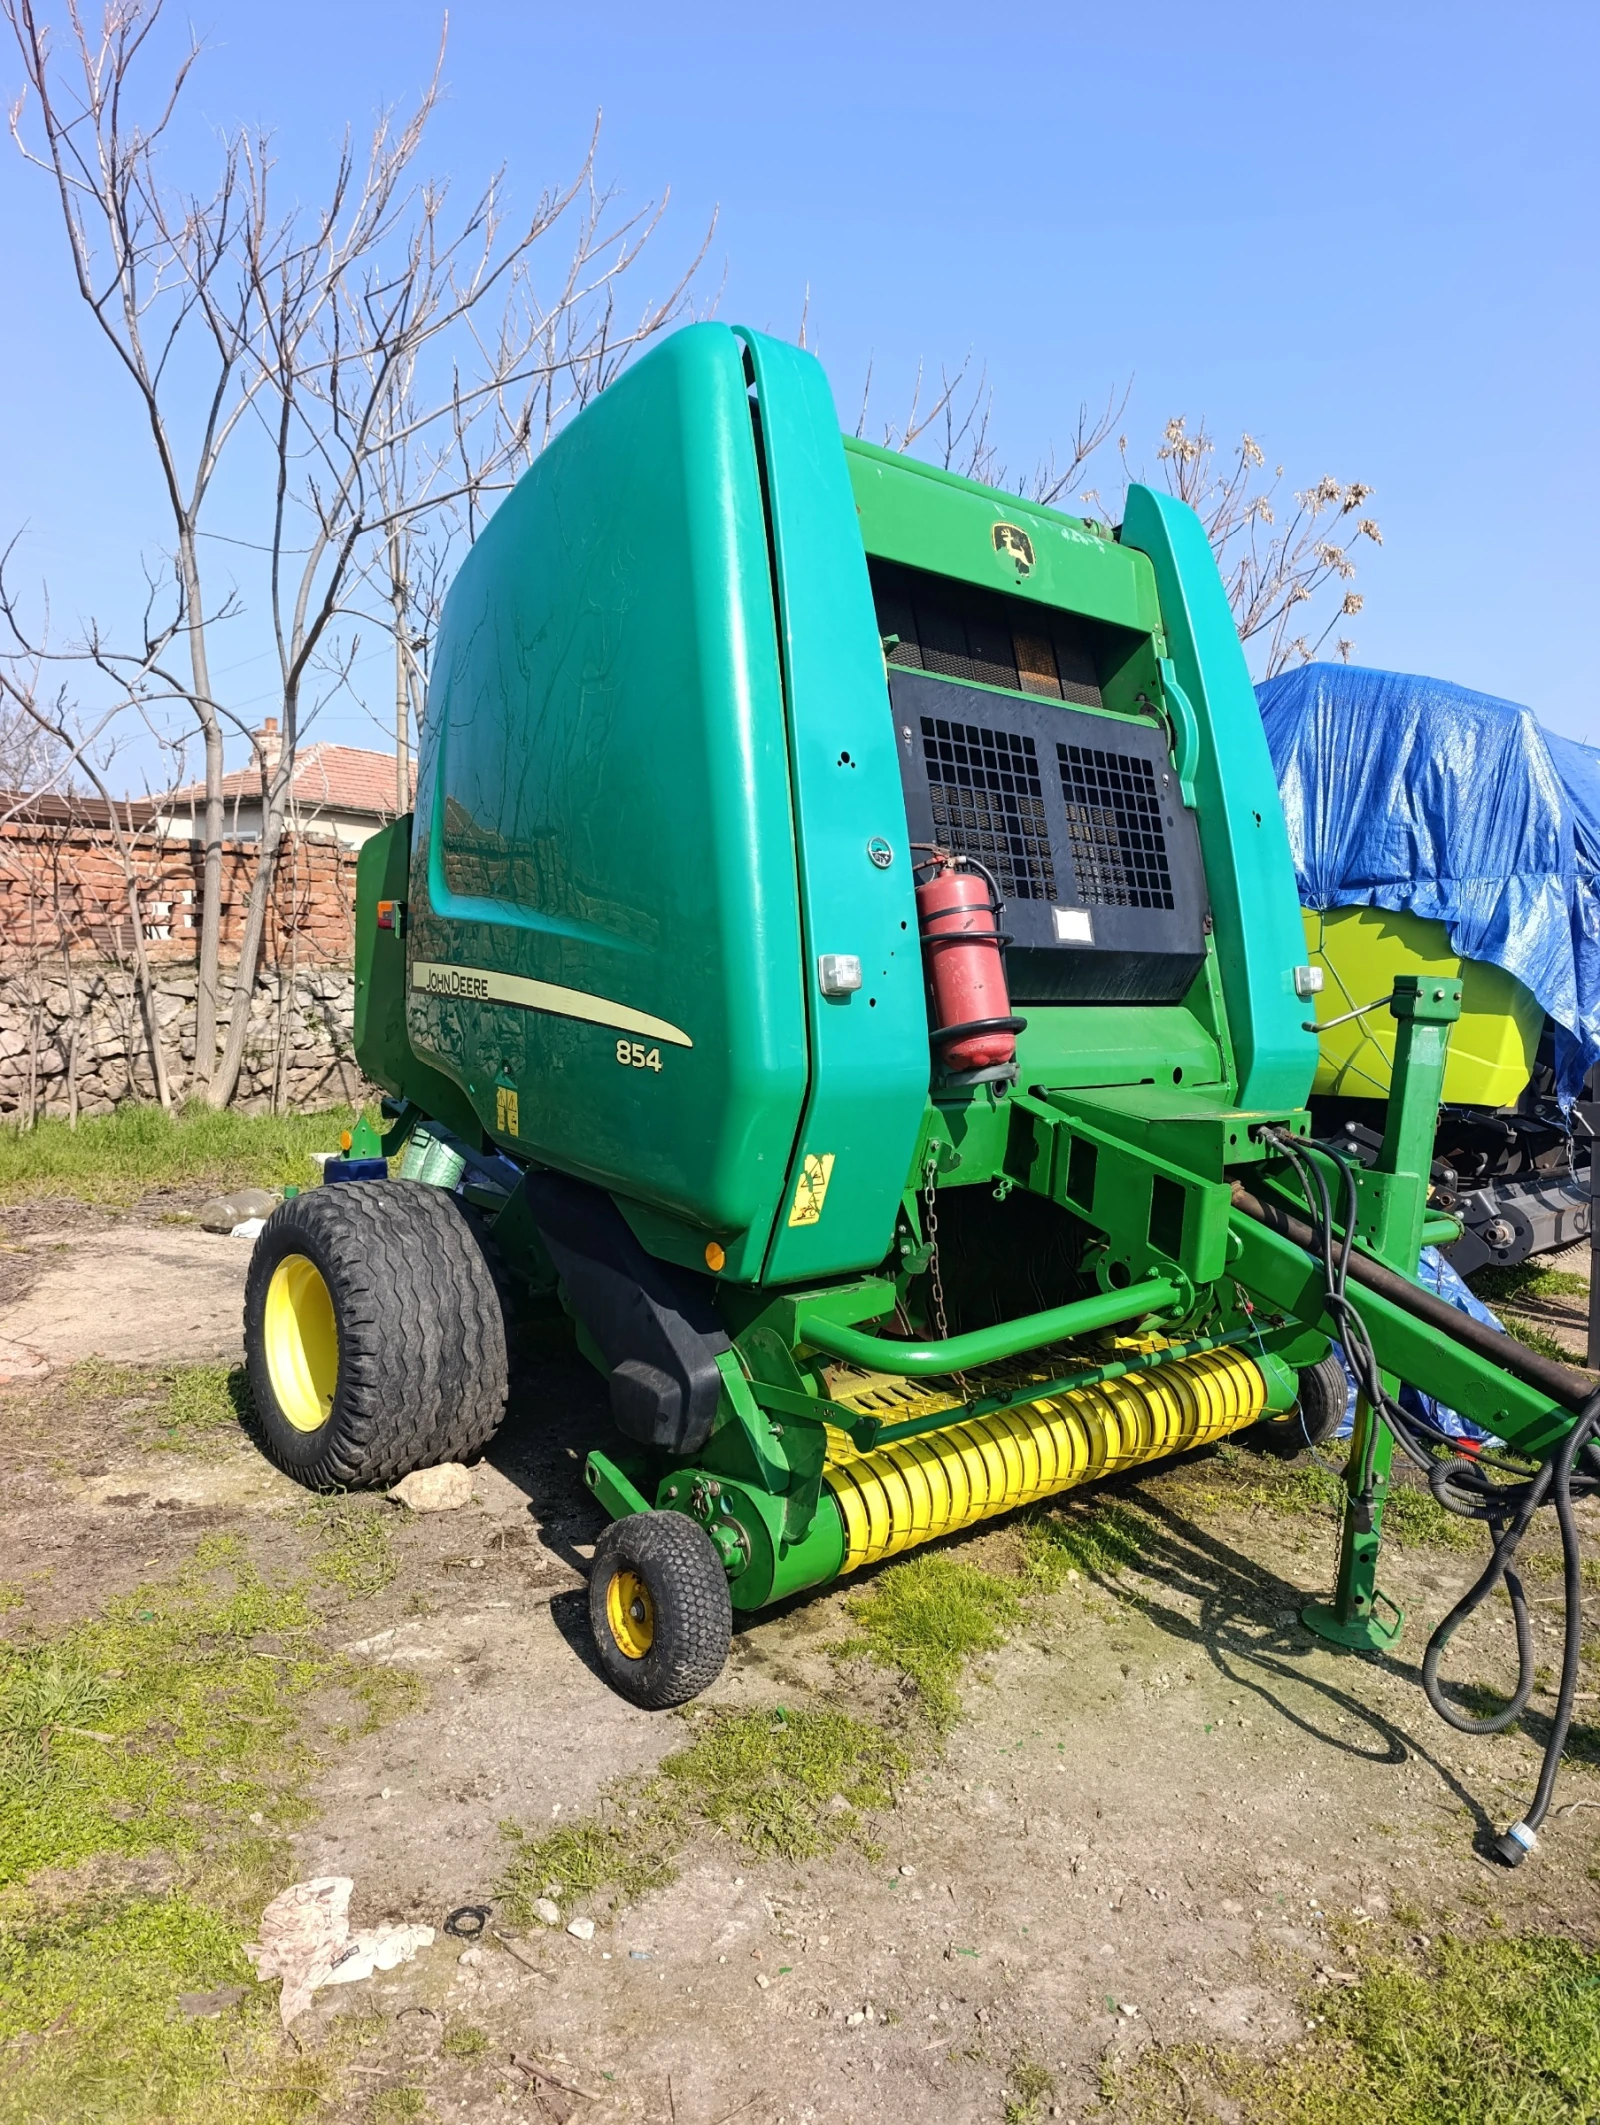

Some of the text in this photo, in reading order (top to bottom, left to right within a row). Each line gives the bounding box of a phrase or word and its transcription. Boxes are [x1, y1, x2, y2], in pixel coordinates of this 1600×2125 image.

[426, 969, 489, 998] JOHN DEERE
[616, 1039, 663, 1073] 854
